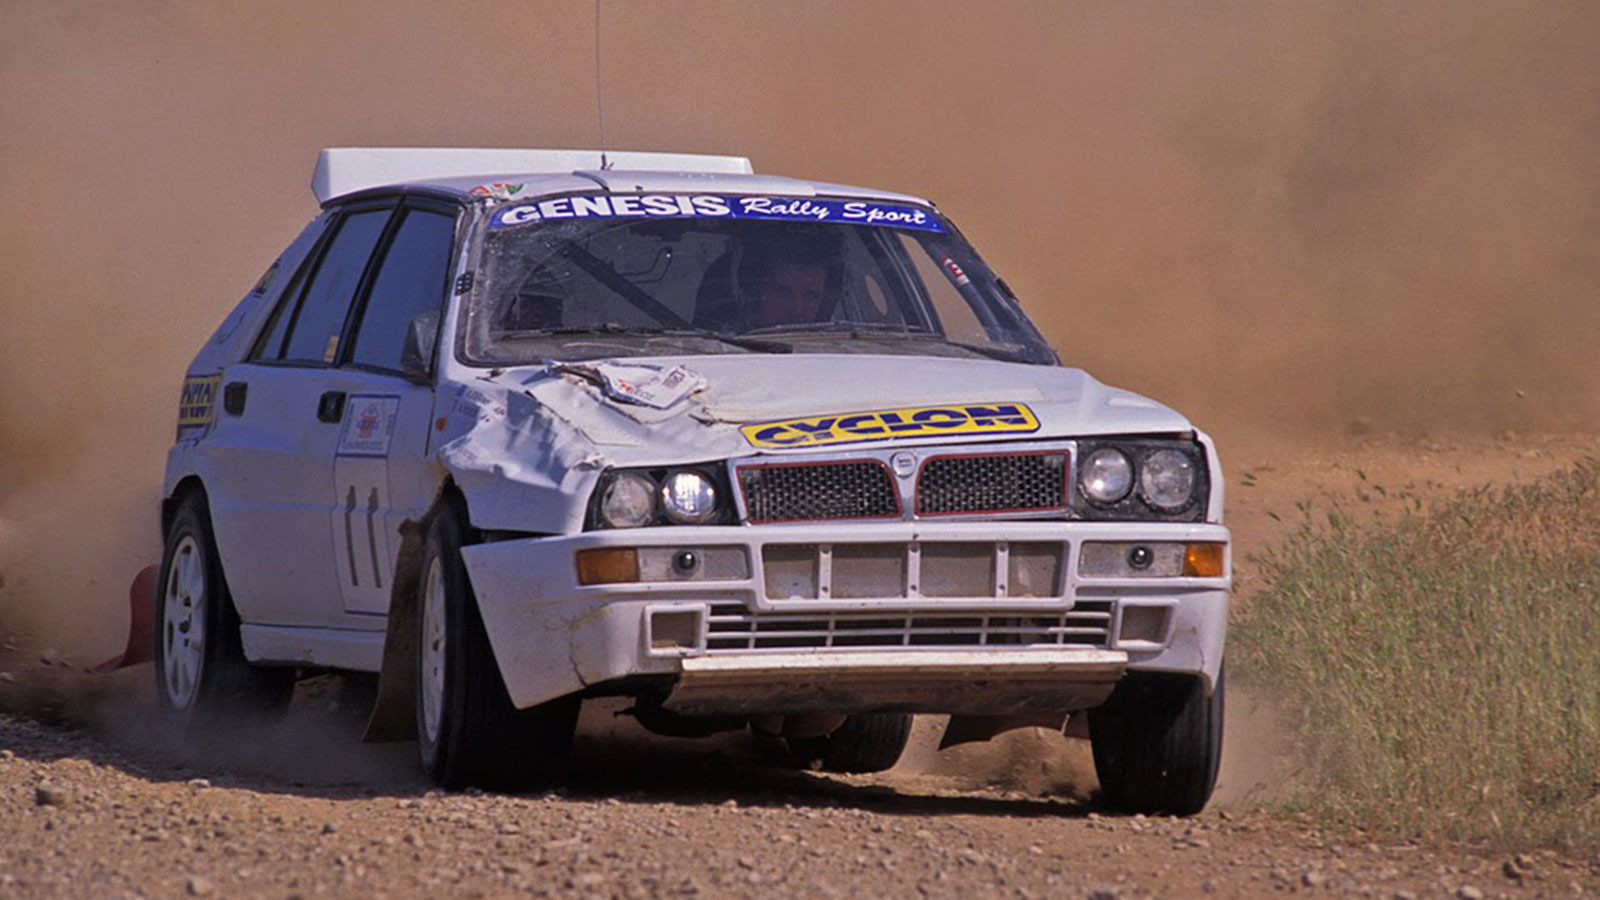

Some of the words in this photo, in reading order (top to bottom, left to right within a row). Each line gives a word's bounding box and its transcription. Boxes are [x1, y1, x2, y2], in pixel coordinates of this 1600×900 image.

[500, 195, 731, 225] GENESIS
[739, 197, 831, 220] Rally
[842, 202, 927, 225] Sport
[754, 405, 1029, 445] CYCLON
